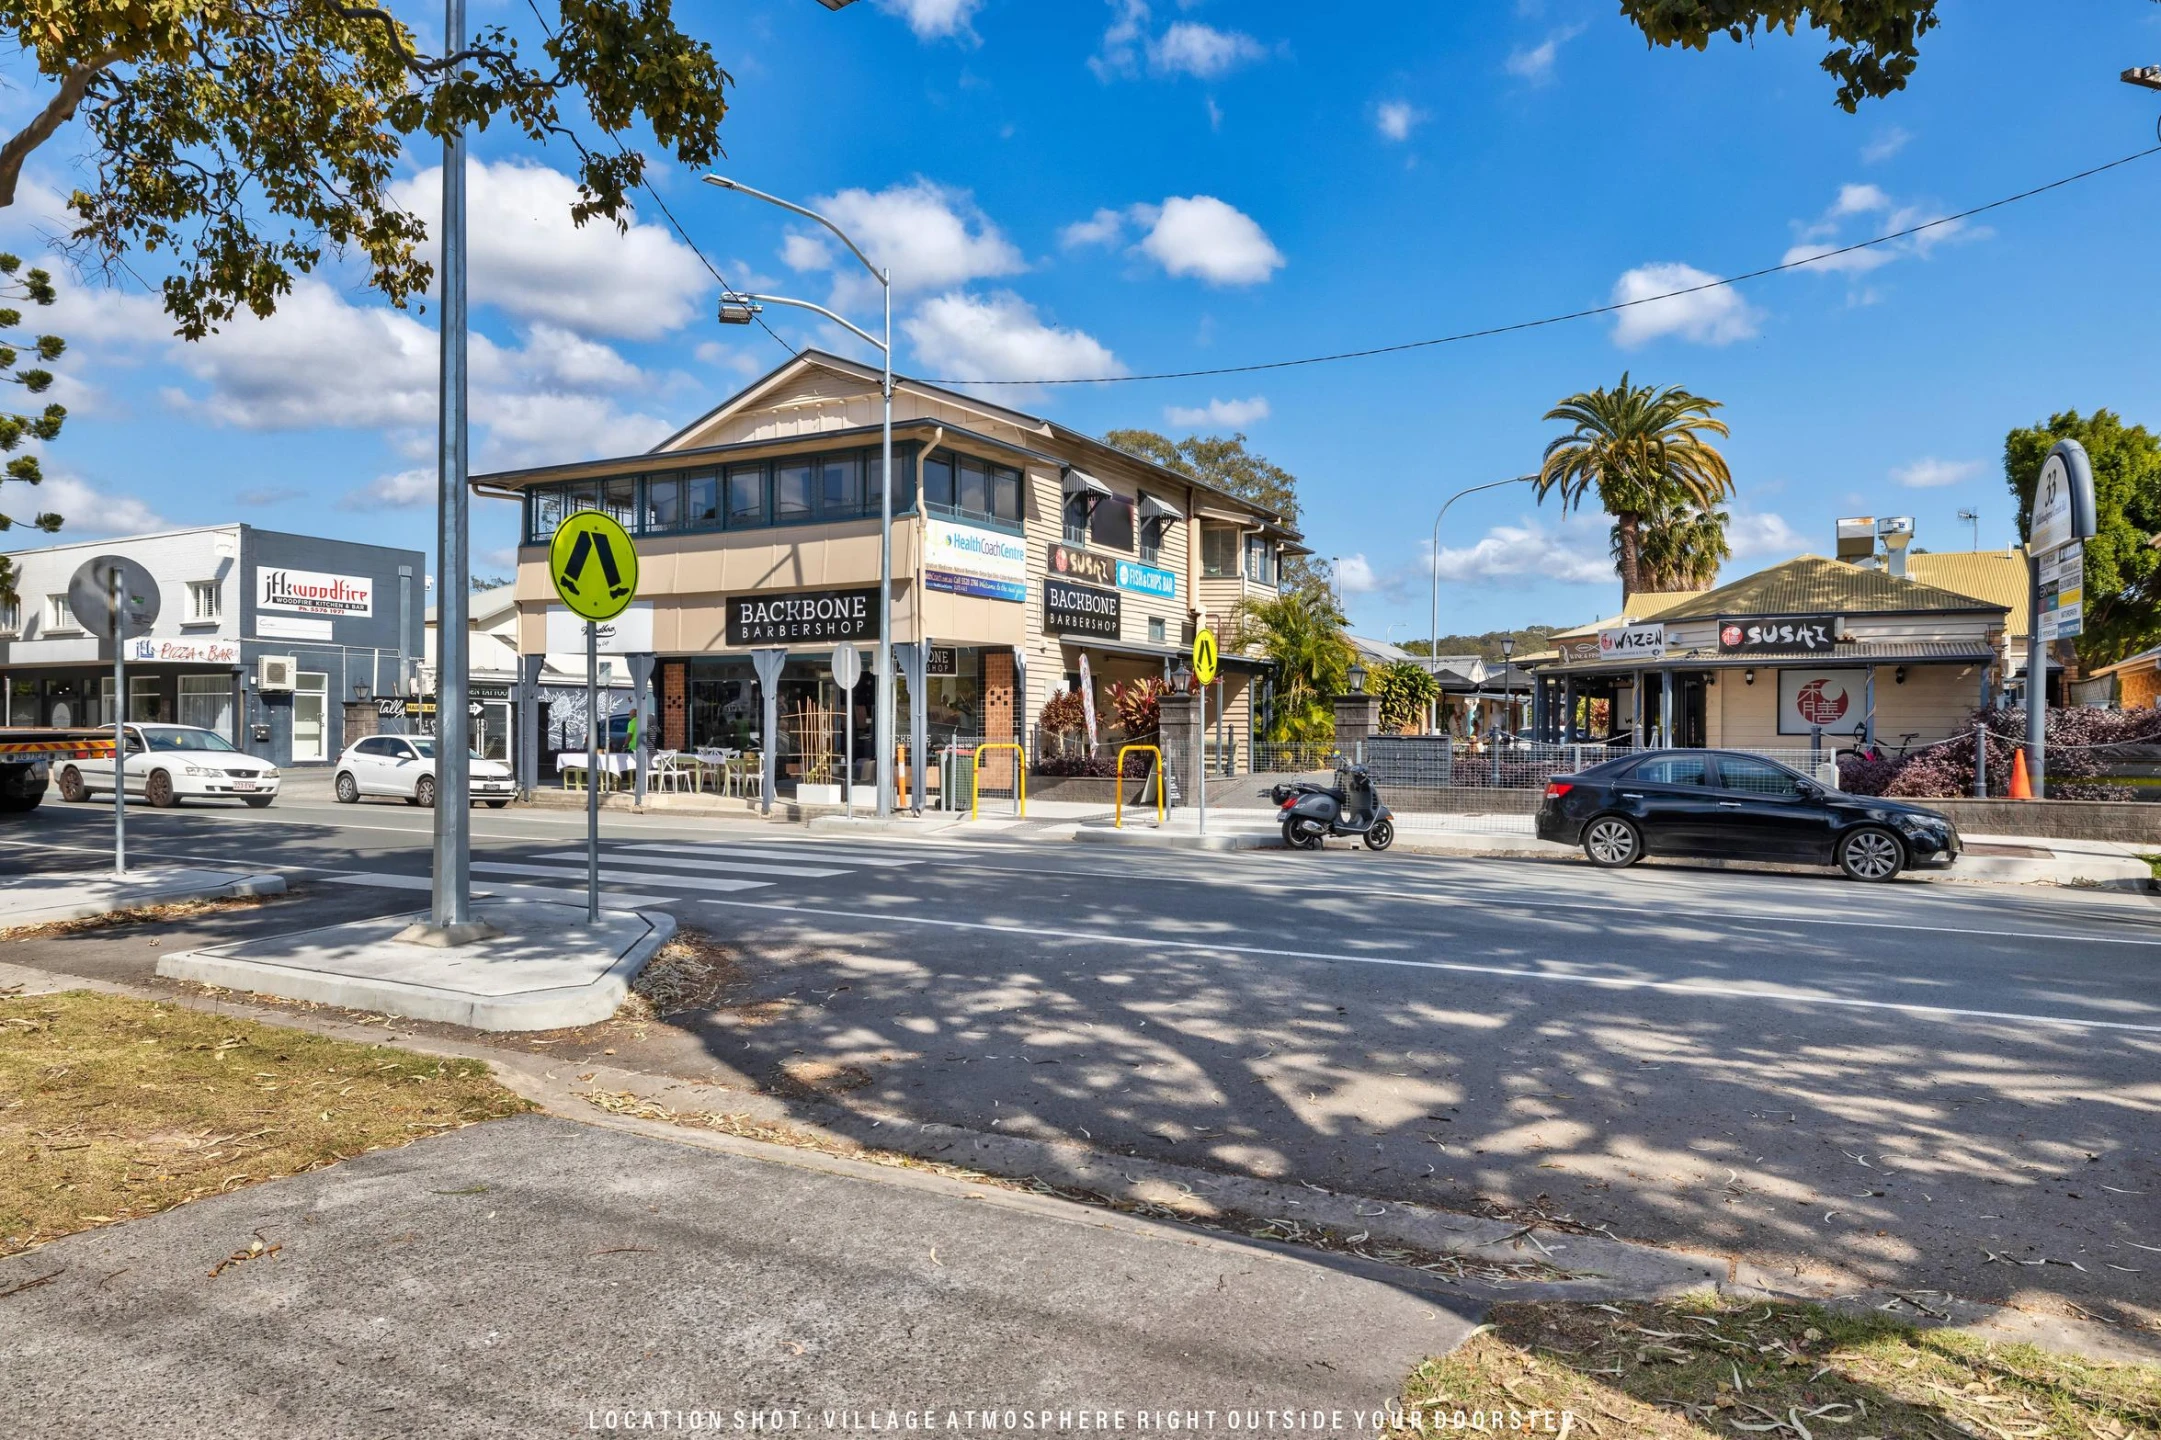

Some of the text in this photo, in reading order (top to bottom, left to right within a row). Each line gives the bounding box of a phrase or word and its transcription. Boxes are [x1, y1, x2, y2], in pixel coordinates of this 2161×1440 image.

[2045, 469, 2056, 507] 33
[953, 534, 1024, 561] HealthCoachCentre
[1070, 553, 1108, 583] SUSHI
[1162, 575, 1172, 593] BAR
[276, 597, 313, 606] WOODFIRE
[315, 600, 343, 608] KITCHEN
[740, 596, 866, 624] BACKBONE
[1050, 588, 1117, 616] BACKBONE
[742, 620, 864, 638] BARBERSHOP
[1050, 613, 1117, 632] BARBERSHOP
[1614, 629, 1662, 649] WAZEN
[1746, 623, 1829, 649] SUSHI
[160, 643, 195, 660] PIZZA
[207, 645, 233, 662] BAR
[482, 687, 508, 696] TATTOO
[375, 699, 406, 718] Tally
